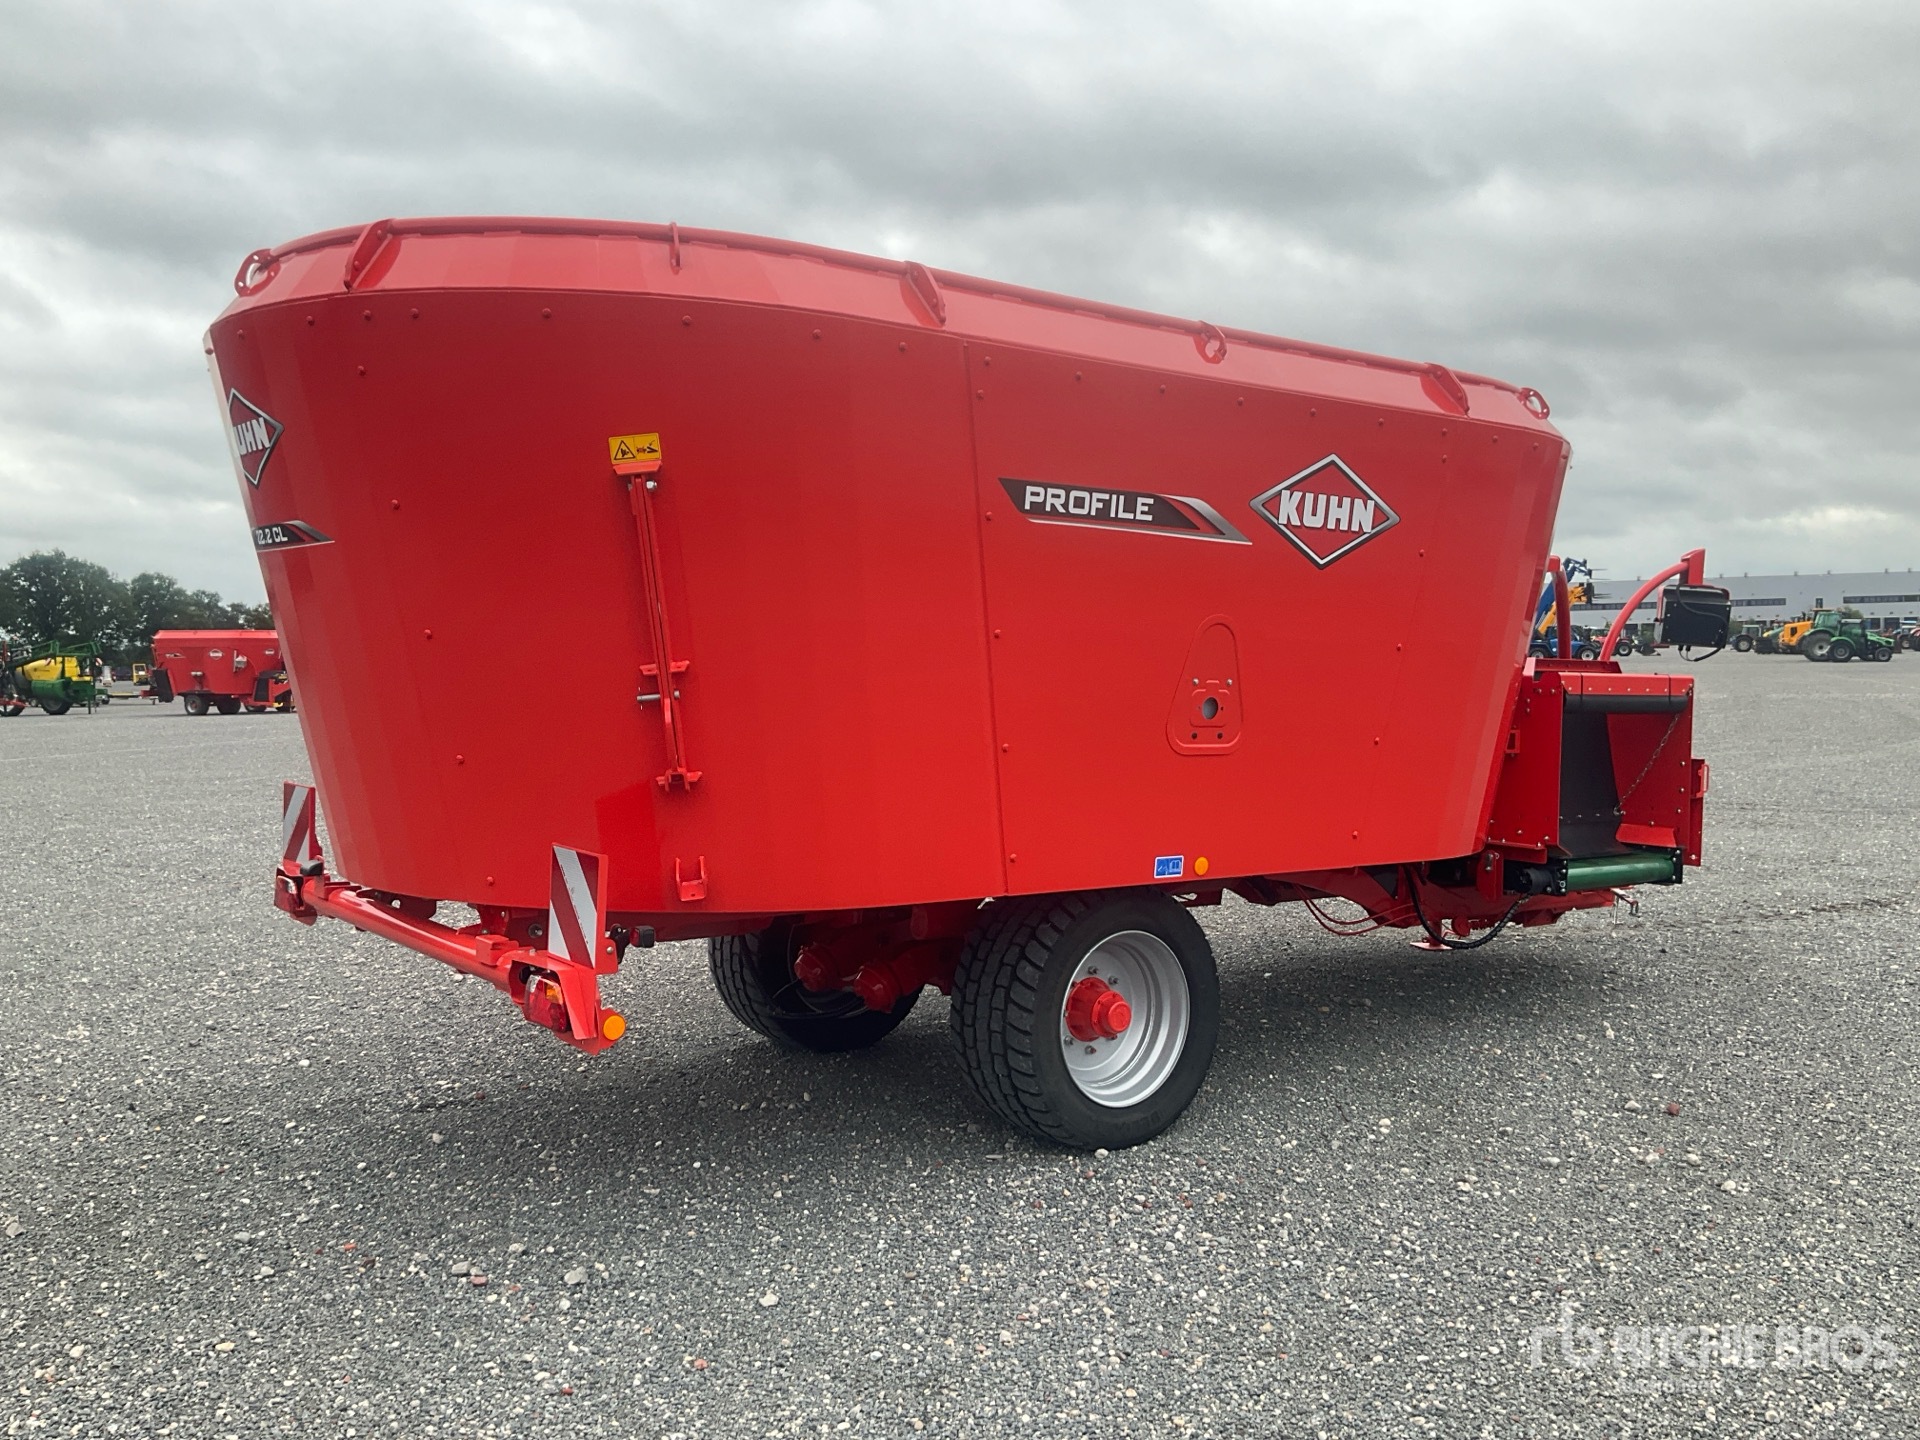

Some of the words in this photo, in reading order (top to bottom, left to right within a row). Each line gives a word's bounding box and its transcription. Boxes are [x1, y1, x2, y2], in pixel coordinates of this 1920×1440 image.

[232, 416, 271, 455] UHN
[1023, 485, 1155, 522] PROFILE
[1277, 489, 1375, 534] KUHN
[272, 526, 288, 543] CL
